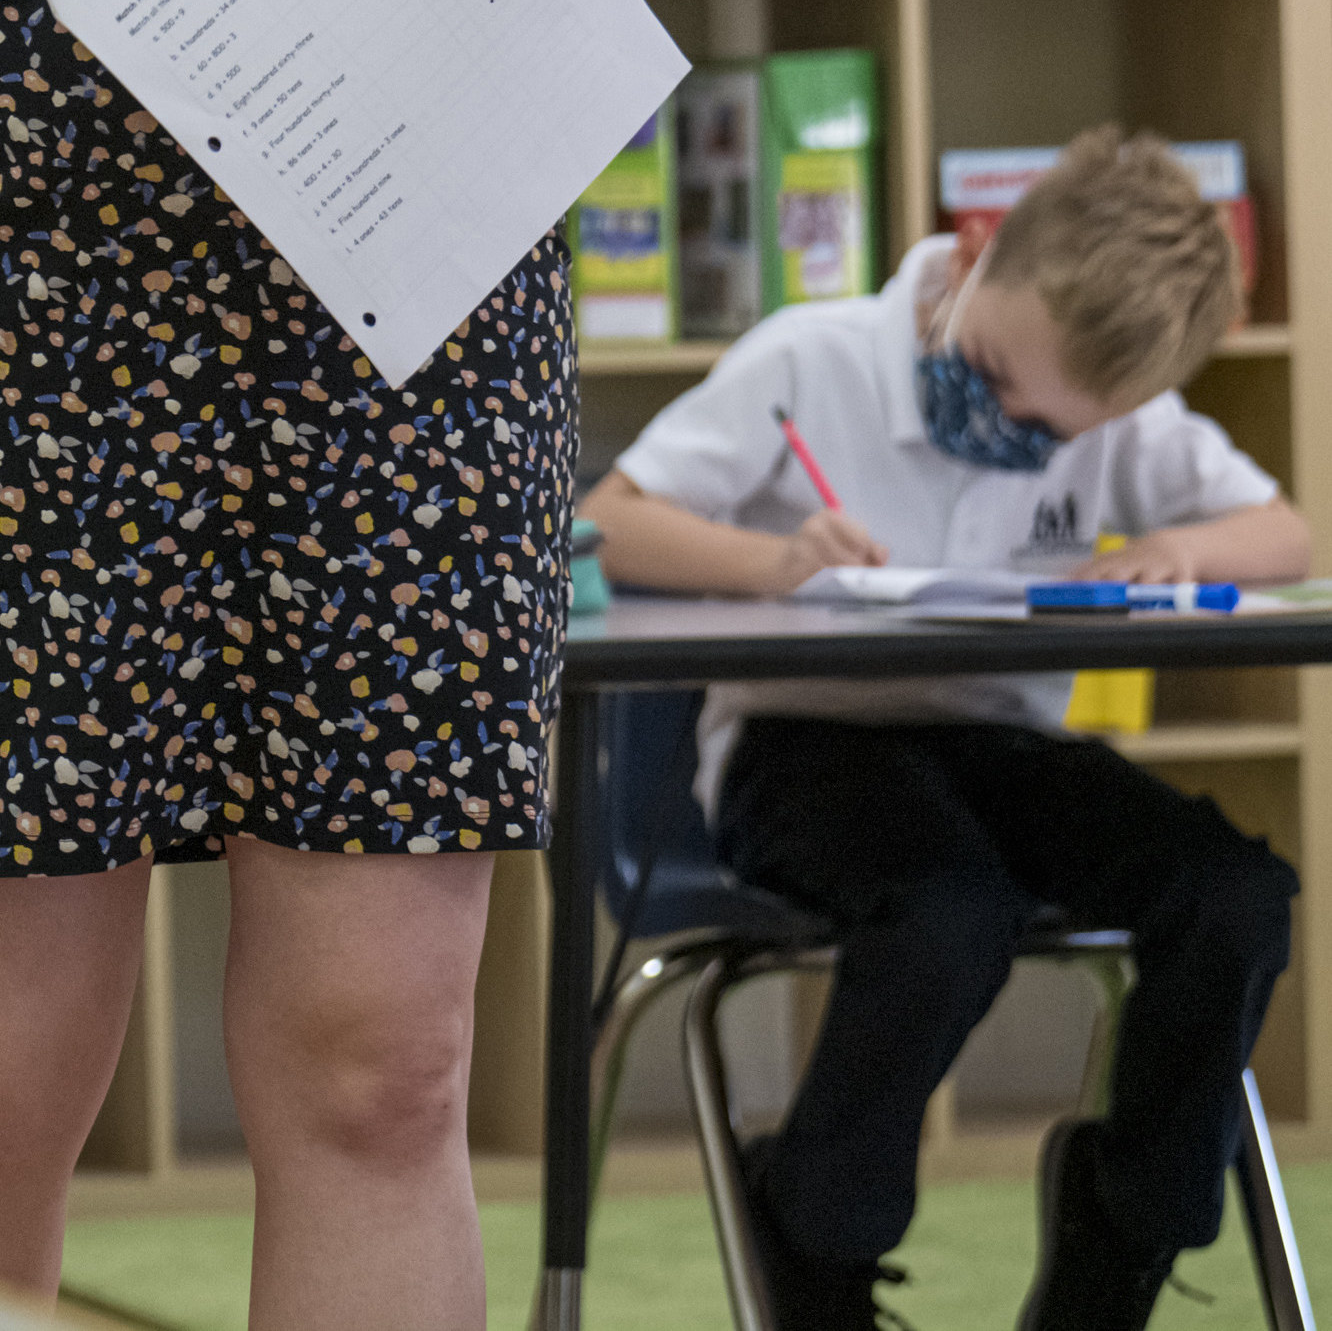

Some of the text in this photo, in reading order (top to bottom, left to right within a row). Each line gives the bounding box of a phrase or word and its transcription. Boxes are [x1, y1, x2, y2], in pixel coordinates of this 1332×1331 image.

[115, 2, 137, 23] Match
[197, 60, 208, 72] 60
[225, 64, 241, 80] 500
[232, 91, 252, 111] Eight
[251, 65, 279, 93] hundred
[278, 32, 314, 68] sixty-three
[258, 108, 274, 124] ones
[276, 93, 288, 105] 50
[287, 79, 303, 95] tens
[268, 132, 285, 149] Four
[284, 106, 312, 133] hundred
[310, 73, 345, 108] thirty-four
[297, 143, 313, 158] tens
[323, 118, 338, 134] ones
[303, 173, 318, 187] 400
[331, 149, 342, 161] 30
[326, 186, 342, 201] tens
[351, 147, 381, 177] hundreds
[390, 123, 406, 139] ones
[337, 211, 353, 226] Five
[351, 184, 379, 213] hundred
[378, 173, 392, 187] nine
[359, 225, 375, 241] ones
[379, 210, 389, 221] 43
[387, 197, 403, 212] tens
